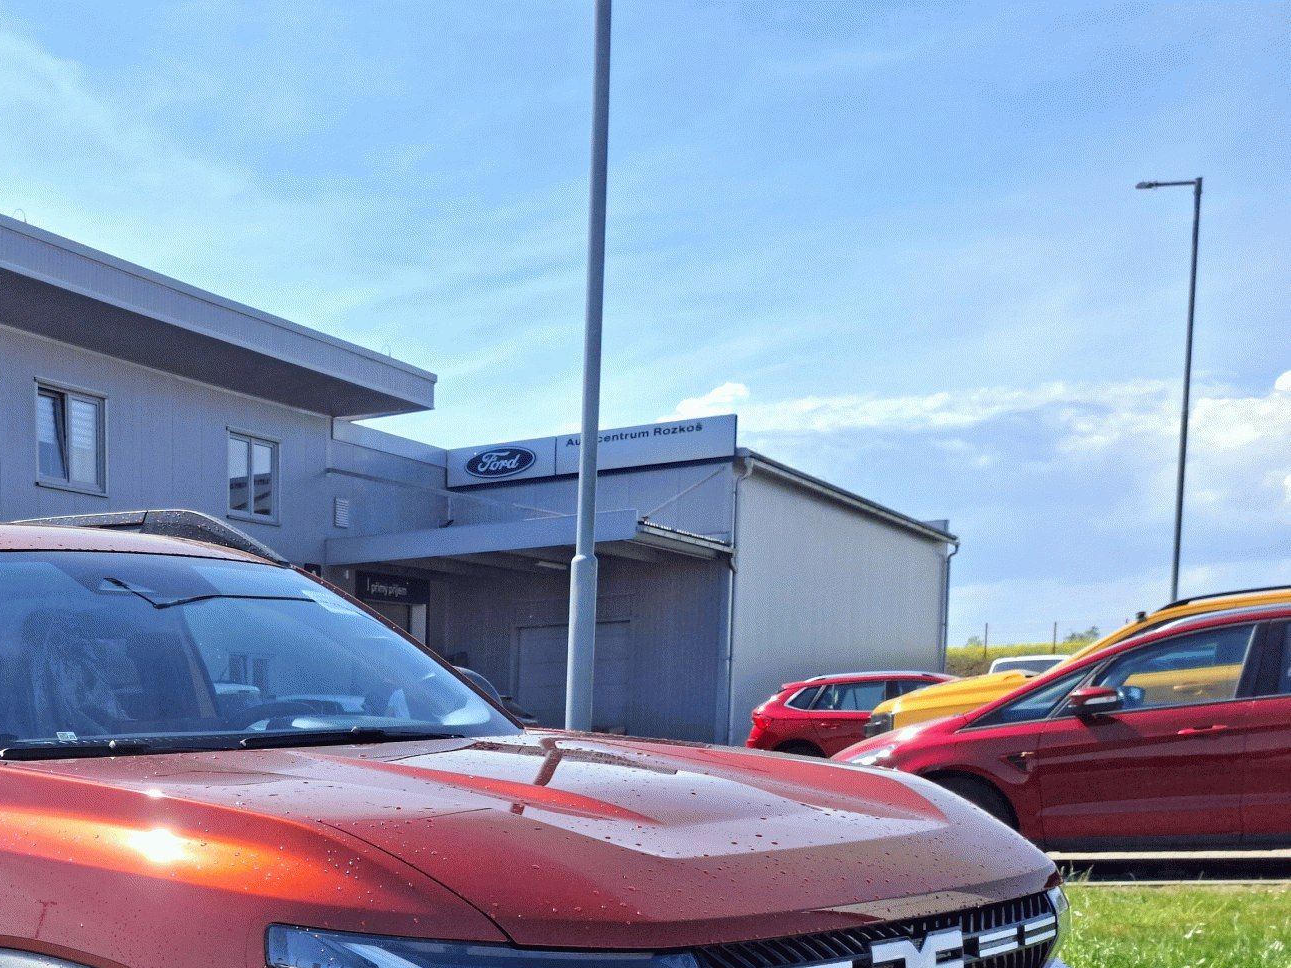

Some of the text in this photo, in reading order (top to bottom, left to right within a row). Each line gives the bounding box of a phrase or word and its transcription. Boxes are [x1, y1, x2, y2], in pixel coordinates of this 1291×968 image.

[565, 422, 703, 447] Aucentrum Rozkoš
[477, 451, 521, 472] Ford
